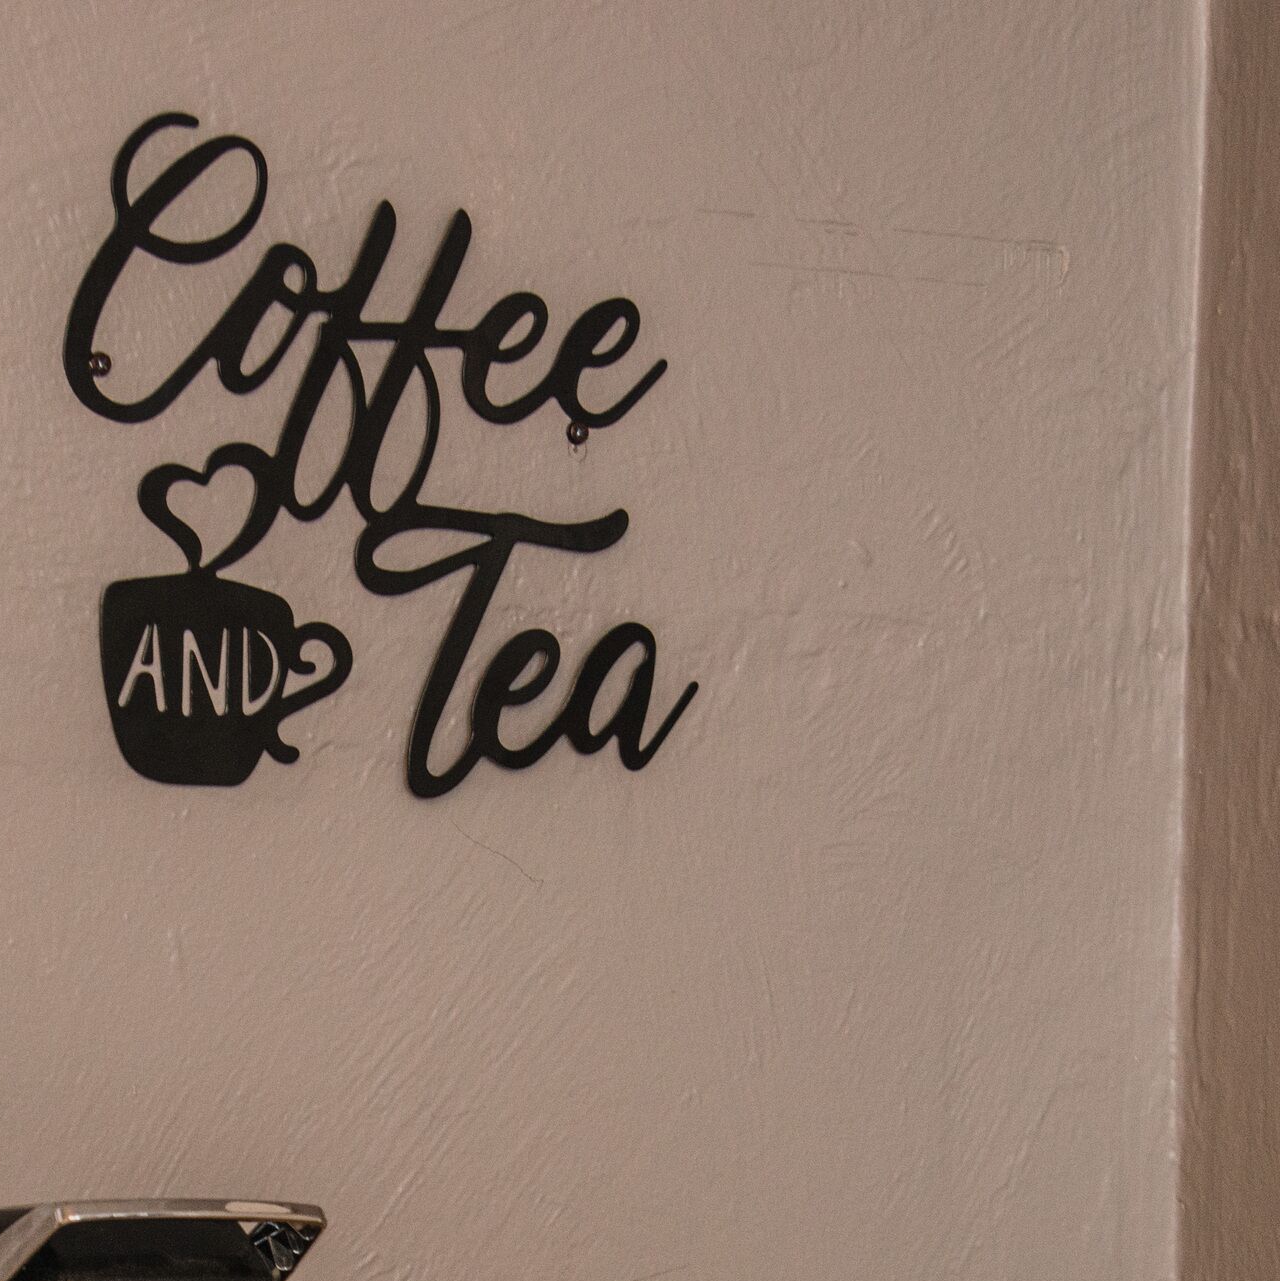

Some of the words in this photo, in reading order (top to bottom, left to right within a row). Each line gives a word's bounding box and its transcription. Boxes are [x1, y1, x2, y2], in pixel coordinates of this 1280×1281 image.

[63, 112, 668, 523] Coffee
[117, 622, 280, 718] AND
[354, 505, 699, 800] Tea
